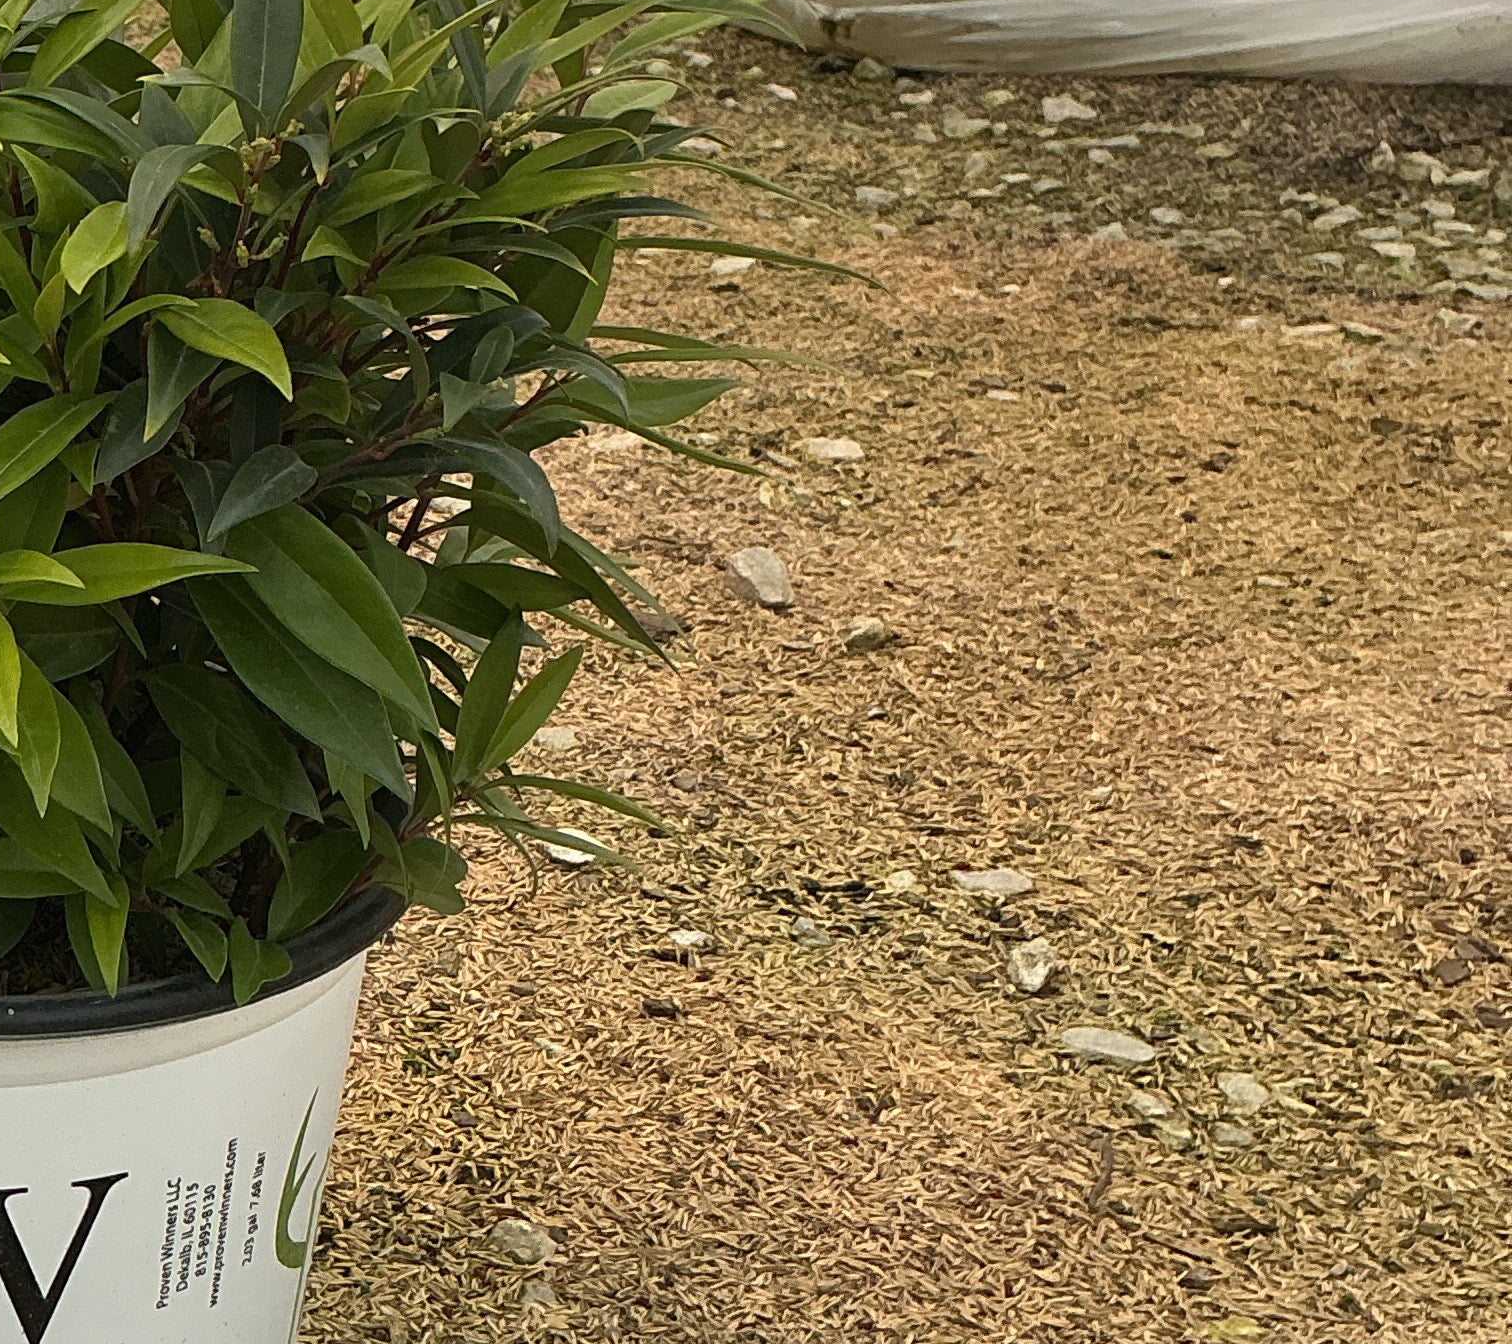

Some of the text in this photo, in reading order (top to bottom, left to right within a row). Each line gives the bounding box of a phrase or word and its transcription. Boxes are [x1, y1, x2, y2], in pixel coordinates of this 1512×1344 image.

[181, 1225, 195, 1241] IL
[183, 1181, 200, 1225] 60115
[194, 1184, 217, 1278] 815-895-8130
[155, 1176, 182, 1310] Proven Winners LLC
